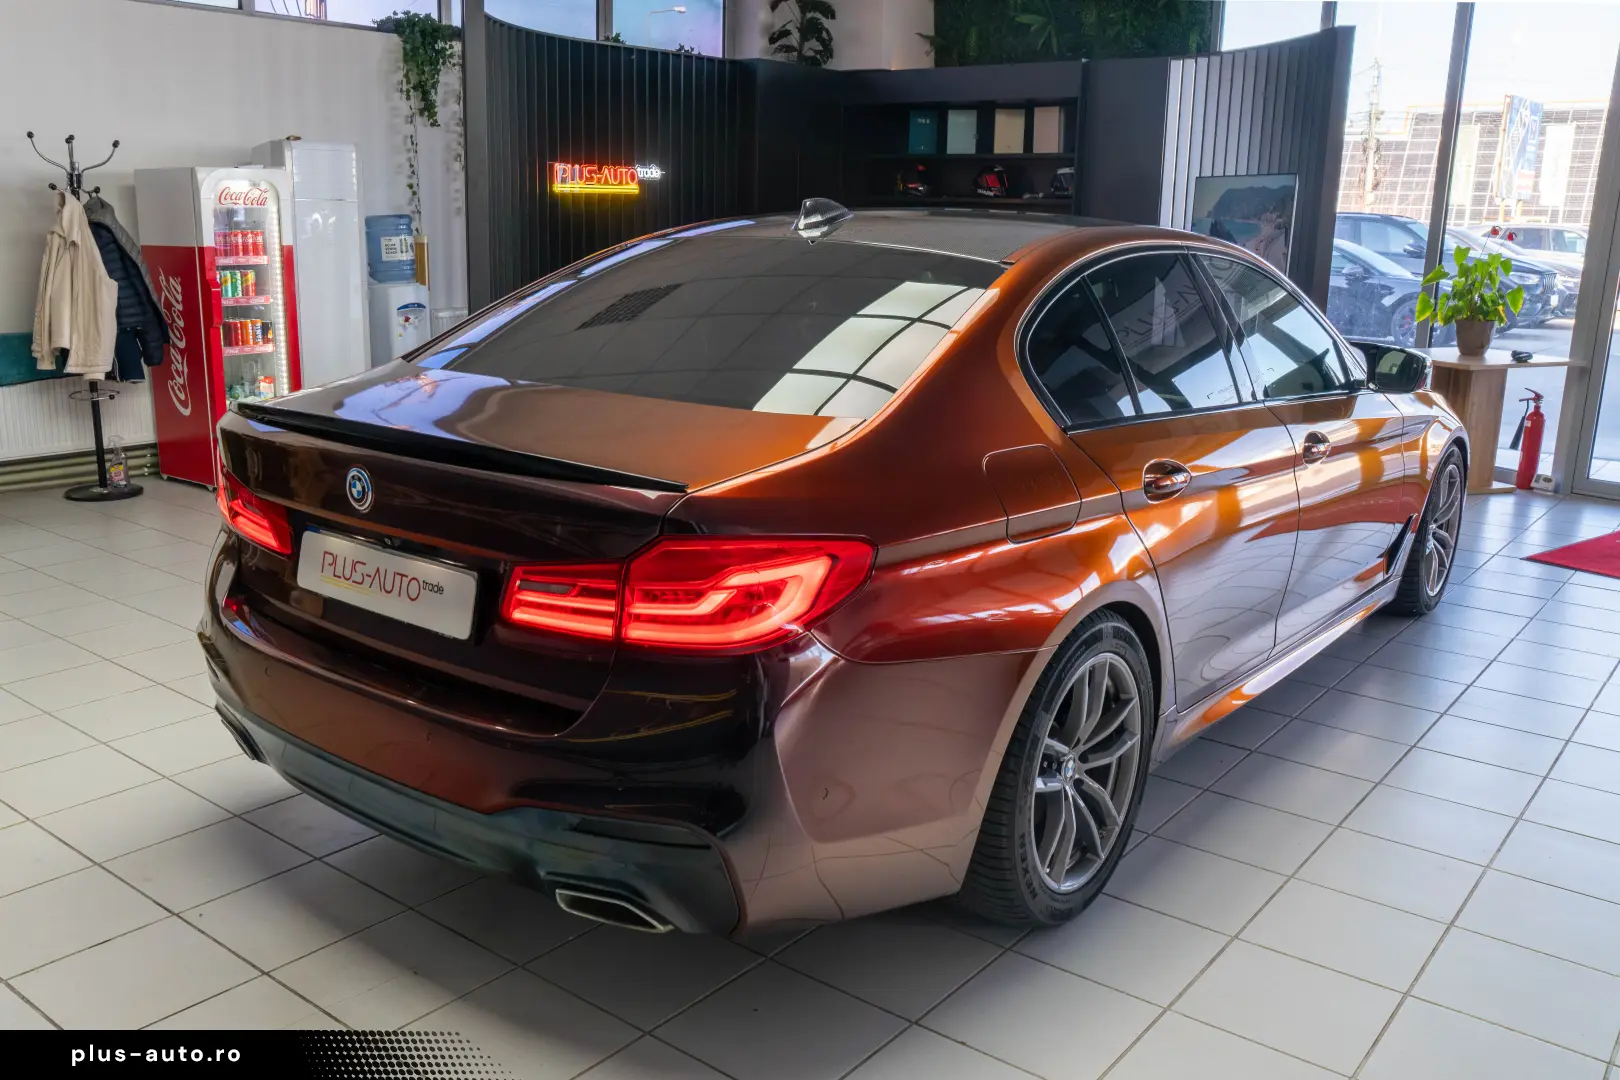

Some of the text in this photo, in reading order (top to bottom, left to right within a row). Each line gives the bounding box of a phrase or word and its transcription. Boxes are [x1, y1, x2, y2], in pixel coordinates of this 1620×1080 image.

[218, 187, 270, 206] Coca-Cola
[555, 164, 660, 185] PLUS-AUTO trade
[158, 266, 192, 416] Coca-Cola
[321, 550, 445, 602] PLUS-AUTO trade
[1019, 832, 1038, 900] NEXEN
